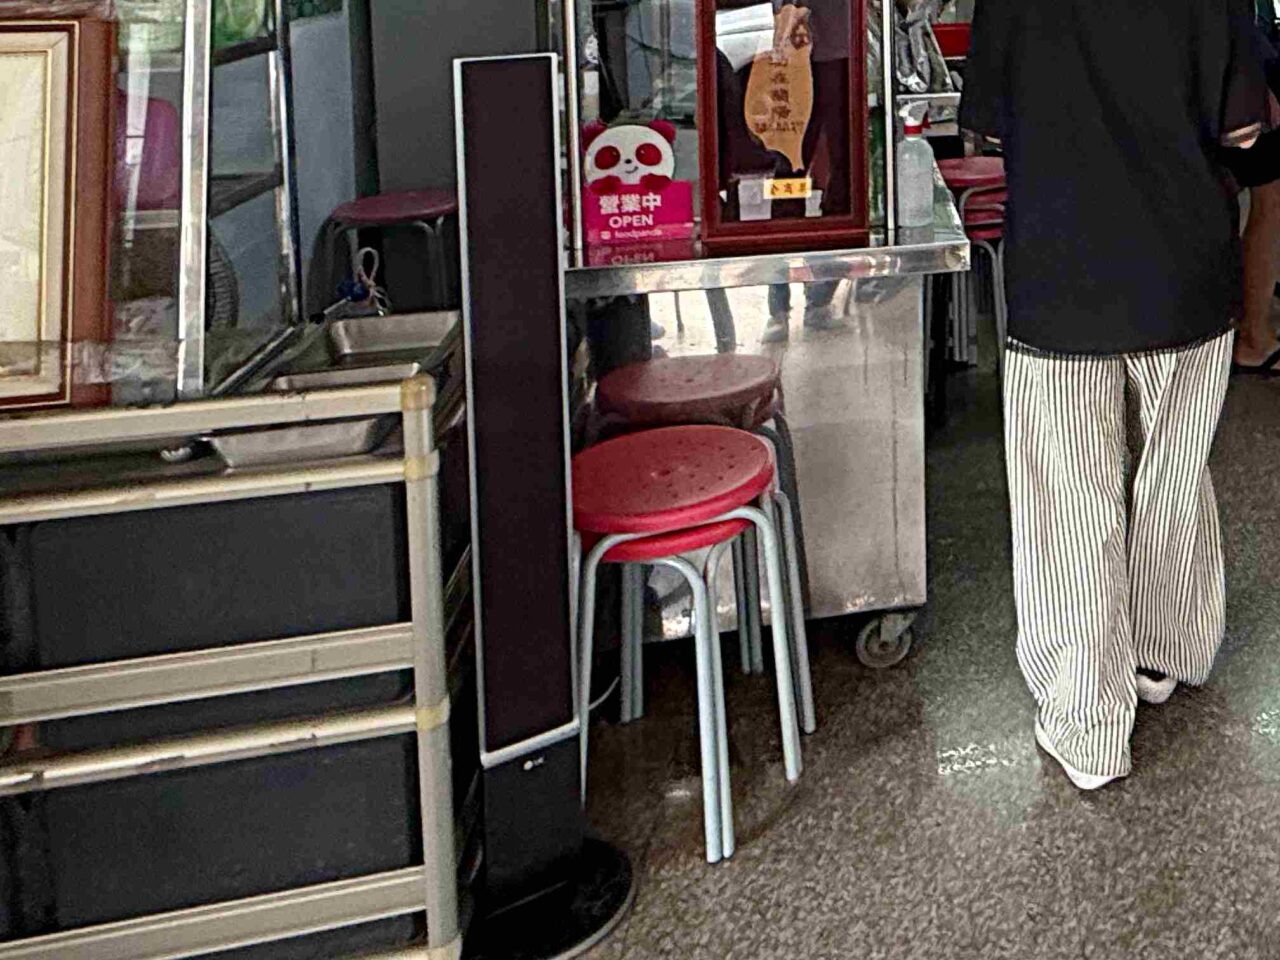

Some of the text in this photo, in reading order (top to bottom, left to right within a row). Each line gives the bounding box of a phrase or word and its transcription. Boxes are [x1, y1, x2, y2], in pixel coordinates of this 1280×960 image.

[599, 192, 662, 215] 營業中
[608, 214, 654, 229] OPEN
